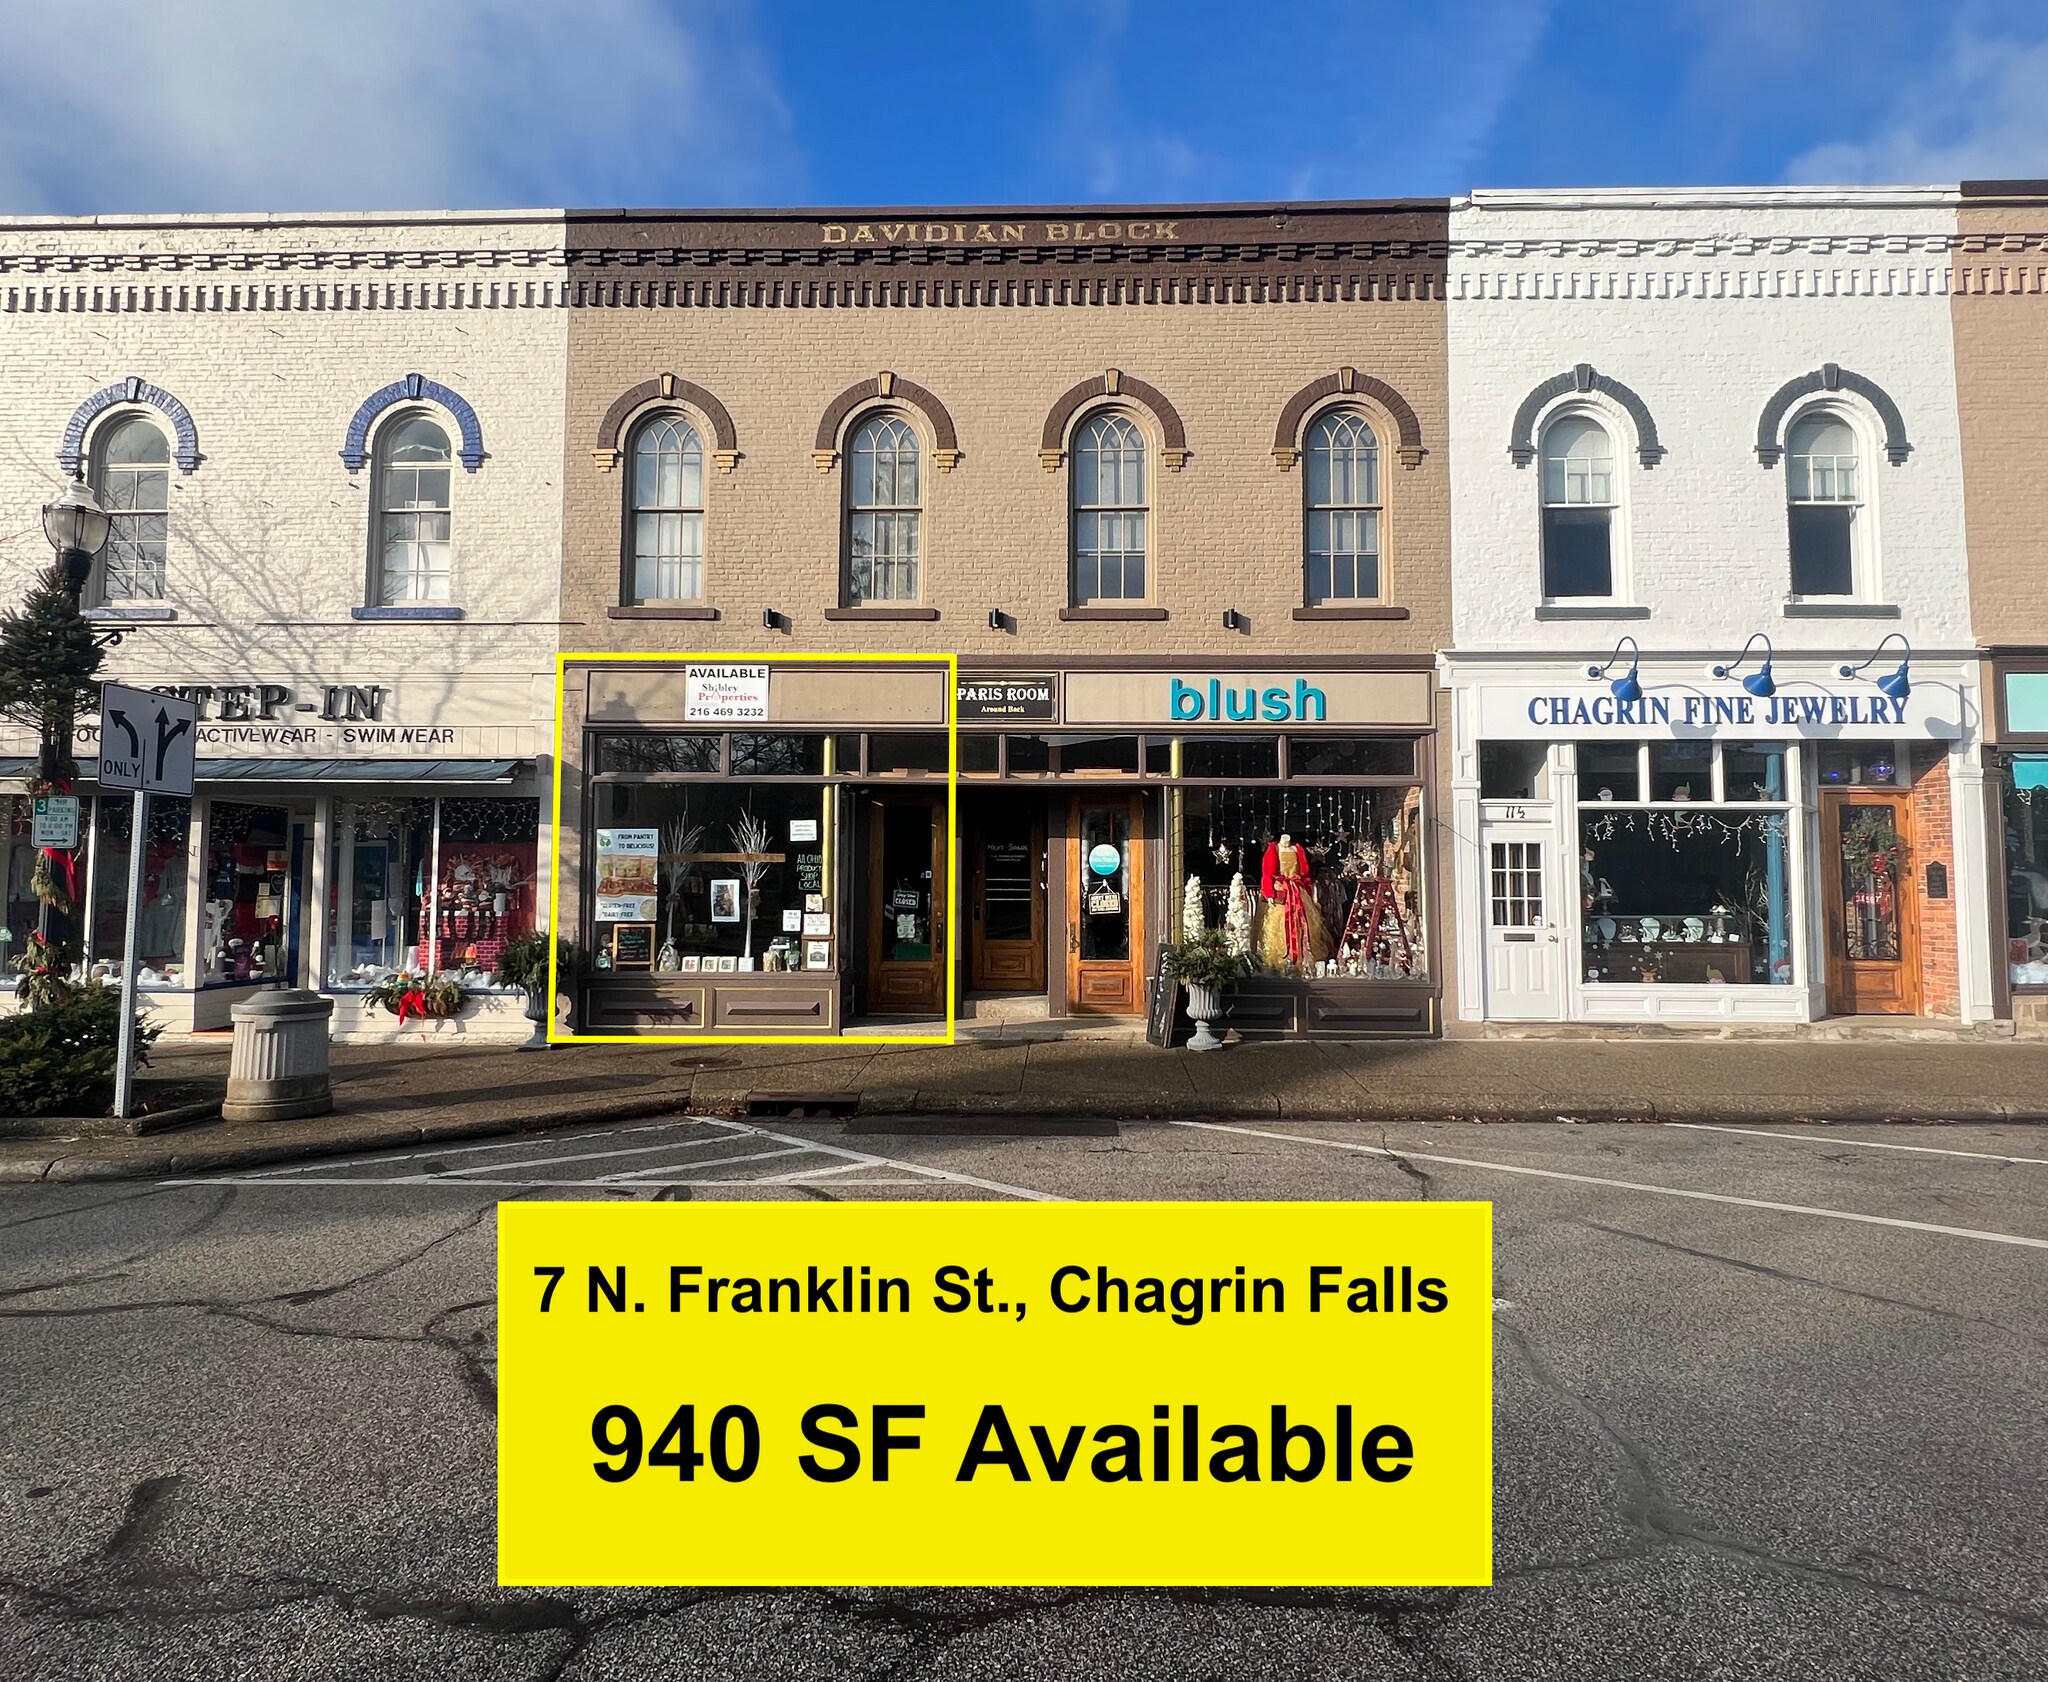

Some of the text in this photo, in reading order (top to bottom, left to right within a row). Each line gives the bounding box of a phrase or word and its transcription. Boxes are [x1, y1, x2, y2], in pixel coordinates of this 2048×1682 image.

[821, 222, 1180, 243] DAVIDIAN BLOCK
[689, 668, 766, 678] AVAILABLE
[702, 683, 738, 694] Shibley
[956, 687, 1050, 701] PARIS ROOM
[152, 685, 382, 722] TEP-IN
[1170, 678, 1327, 721] blush
[690, 707, 764, 716] 216 469 3232
[981, 705, 1025, 713] Around Back
[1528, 696, 1910, 725] CHAGRIN FINE JEWELRY
[196, 728, 317, 745] ACTIVEWEAR
[103, 759, 141, 778] ONLY
[36, 799, 47, 812] 3
[895, 898, 917, 906] CLOSED
